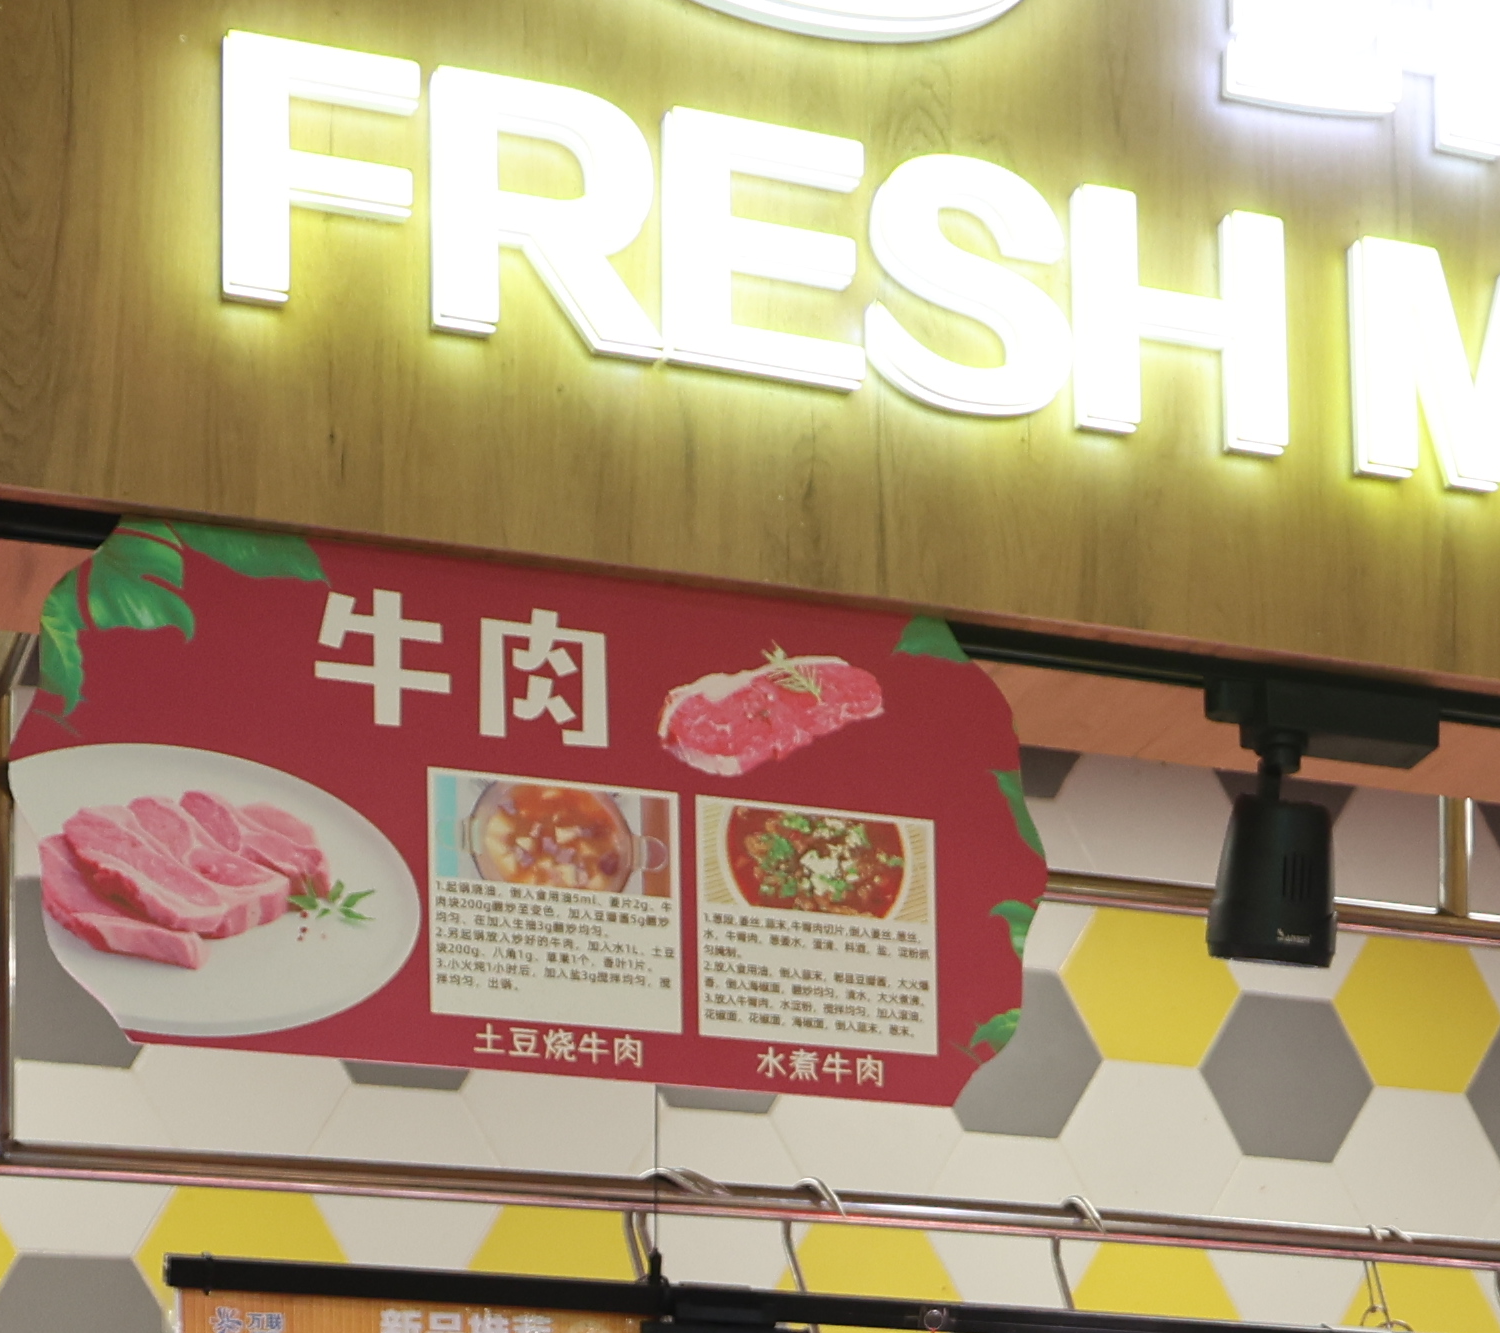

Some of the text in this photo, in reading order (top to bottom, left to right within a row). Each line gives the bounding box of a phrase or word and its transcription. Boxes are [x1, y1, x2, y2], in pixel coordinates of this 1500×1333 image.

[219, 29, 1290, 456] FRESH
[313, 589, 610, 749] 牛肉
[472, 1024, 644, 1068] 土豆烧牛肉
[756, 1046, 886, 1087] 水煮牛肉
